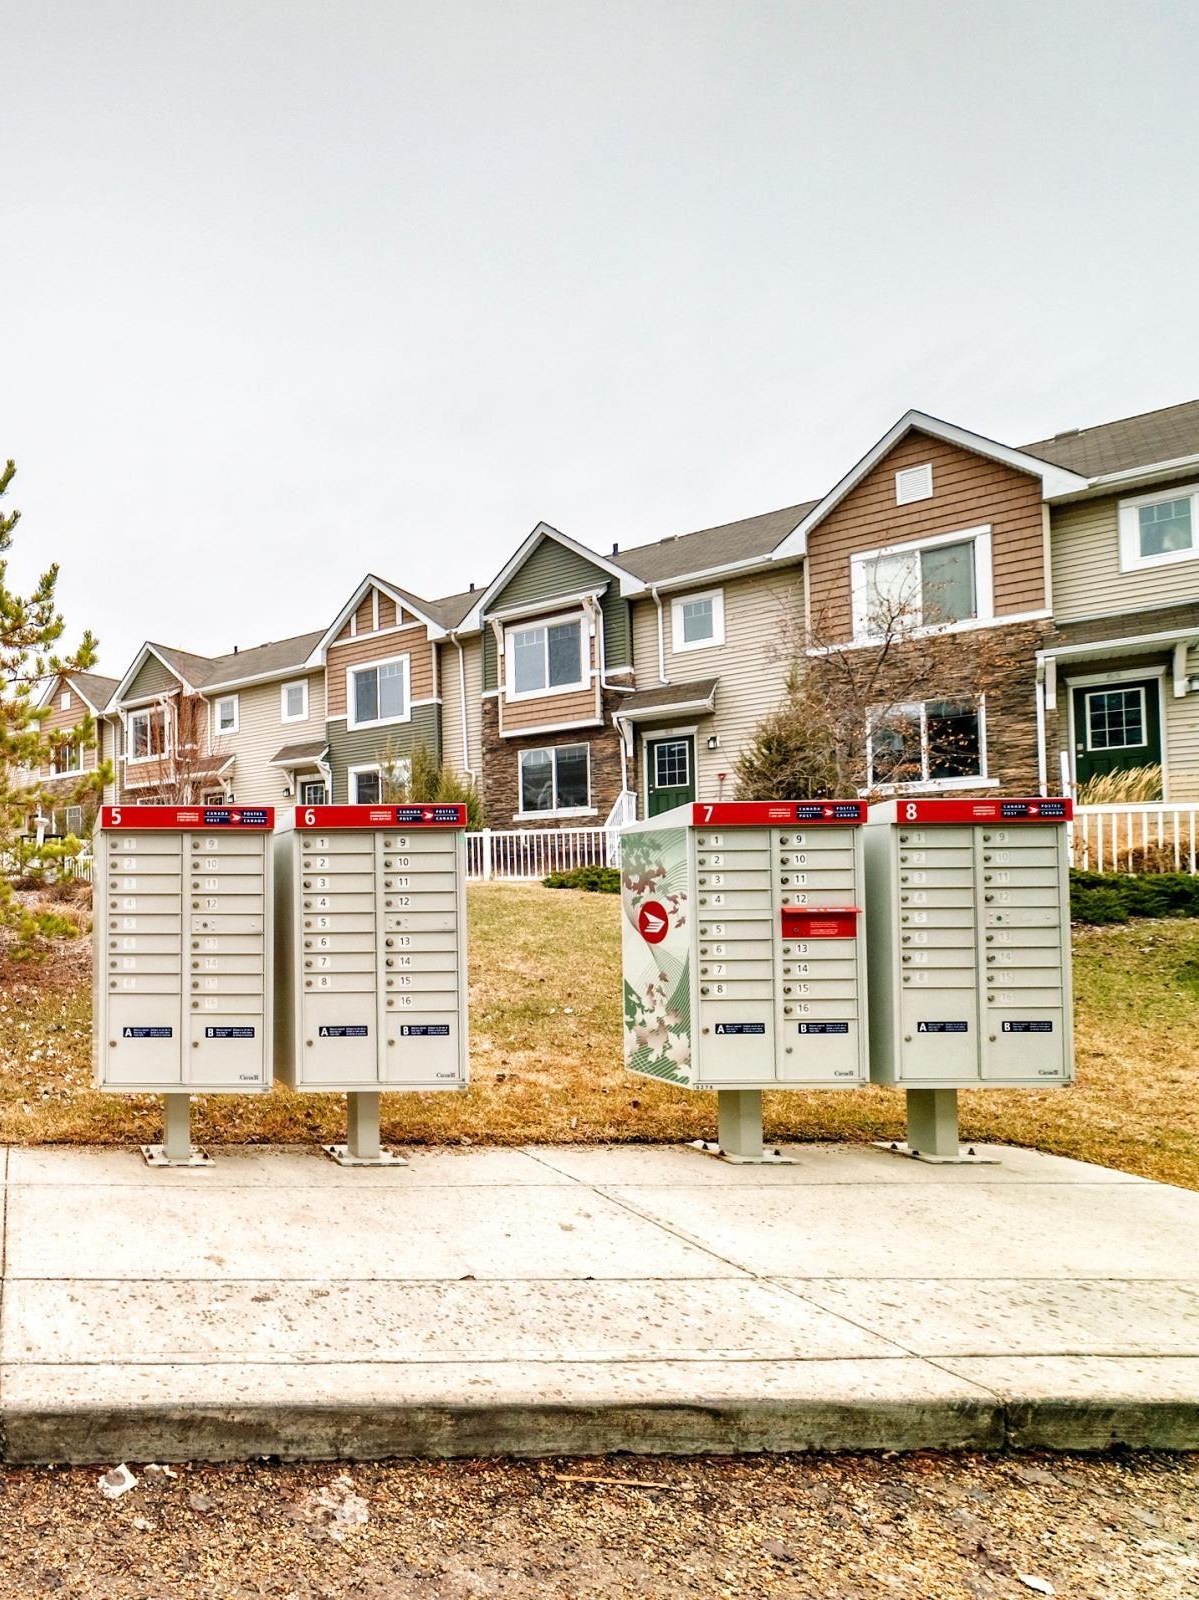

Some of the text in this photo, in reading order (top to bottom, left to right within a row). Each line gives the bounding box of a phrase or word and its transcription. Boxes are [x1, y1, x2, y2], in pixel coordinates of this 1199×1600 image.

[703, 806, 713, 822] 7
[906, 803, 917, 820] 8
[112, 808, 122, 825] 5
[304, 808, 316, 825] 6
[400, 838, 406, 846] 9
[796, 835, 802, 843] 9
[320, 858, 325, 867] 2
[399, 858, 409, 866] 10
[714, 856, 720, 864] 2
[795, 855, 805, 863] 10
[320, 878, 326, 887] 3
[399, 878, 408, 886] 11
[715, 875, 720, 884] 3
[796, 874, 805, 883] 11
[320, 898, 326, 906] 4
[400, 897, 409, 905] 12
[715, 895, 721, 903] 4
[796, 894, 806, 903] 12
[321, 918, 326, 927] 5
[716, 925, 721, 933] 5
[321, 938, 327, 946] 6
[400, 937, 410, 945] 13
[716, 945, 722, 953] 6
[797, 944, 807, 953] 13
[321, 957, 327, 966] 7
[401, 957, 410, 965] 14
[717, 965, 722, 973] 7
[798, 964, 808, 972] 14
[322, 977, 327, 986] 8
[401, 976, 410, 984] 15
[717, 984, 723, 993] 8
[798, 984, 809, 992] 15
[401, 996, 411, 1004] 16
[798, 1004, 809, 1012] 16
[402, 1025, 410, 1034] B
[717, 1025, 725, 1034] A
[800, 1024, 807, 1033] B
[919, 1023, 927, 1031] A
[1004, 1022, 1011, 1031] B
[125, 1027, 132, 1036] A
[207, 1028, 214, 1037] B
[321, 1027, 328, 1036] A
